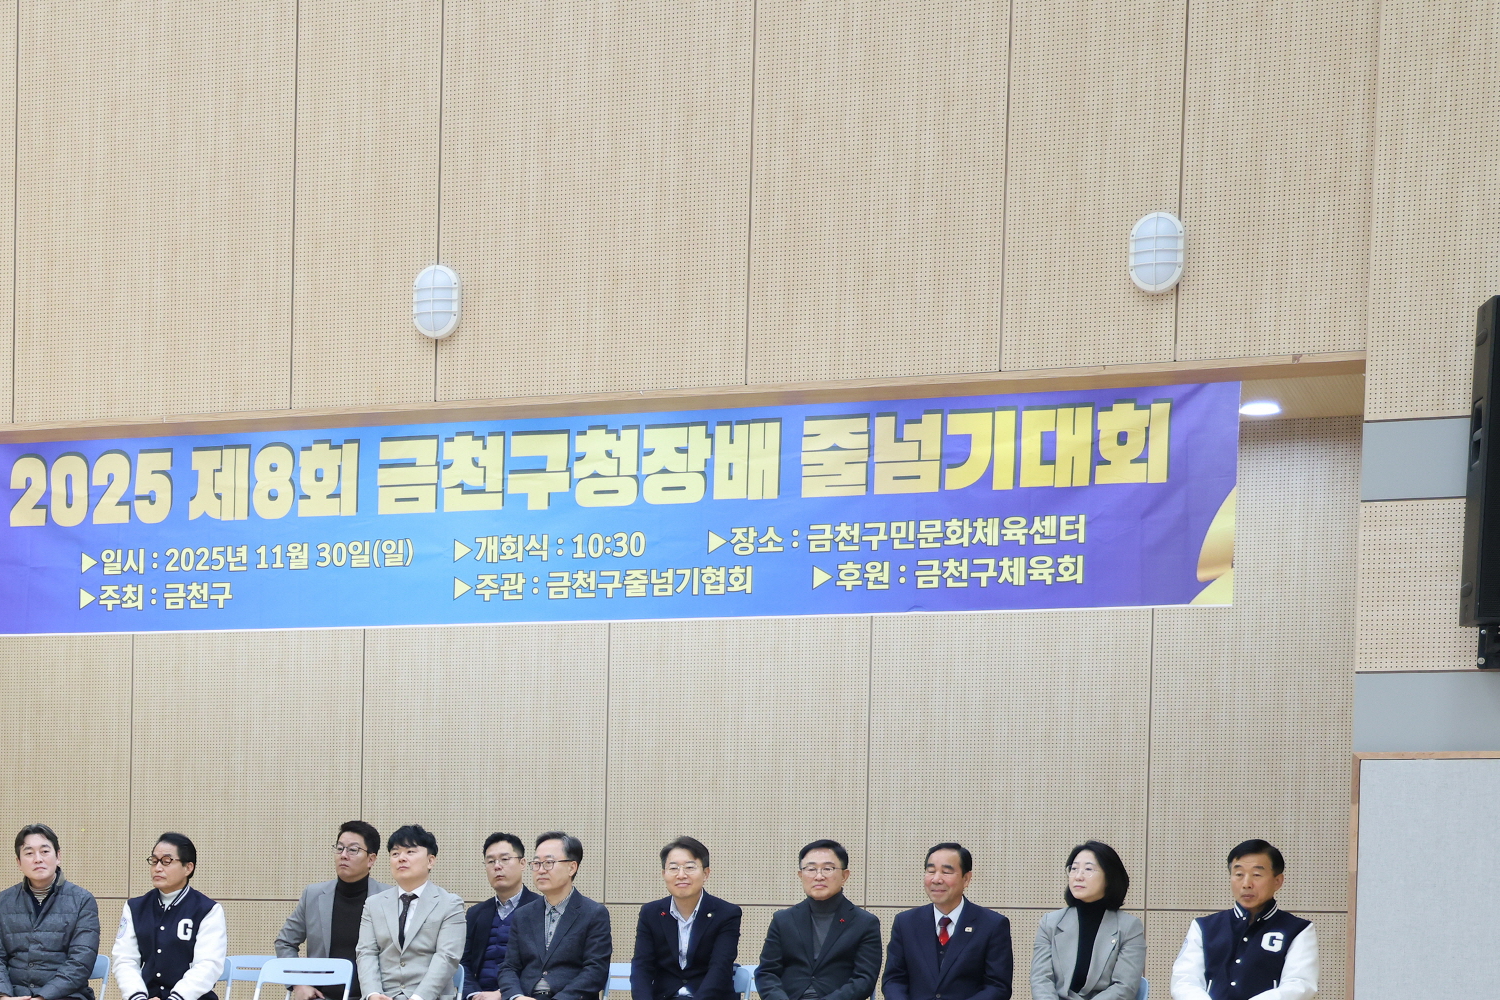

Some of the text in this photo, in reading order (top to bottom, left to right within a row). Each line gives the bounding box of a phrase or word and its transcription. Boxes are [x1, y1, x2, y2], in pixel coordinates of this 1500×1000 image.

[9, 398, 1173, 528] 2025 제8회 금천구청장배 줄넘기대회
[474, 533, 549, 563] 개회식
[571, 532, 646, 559] 10:30
[730, 526, 784, 555] 장소
[807, 515, 1086, 553] 금천구민문화체육센터
[100, 548, 144, 574] 일시
[165, 545, 248, 572] 2025년
[256, 543, 309, 569] 11월
[316, 538, 414, 568] 30일(일)
[835, 561, 890, 591] 후원
[914, 555, 1084, 589] 금천구체육회
[99, 583, 143, 610] 주최
[163, 582, 233, 609] 금천구
[474, 572, 525, 602] 주관
[546, 565, 753, 599] 금천구줄넘기협회
[177, 919, 193, 941] G
[1261, 932, 1284, 952] G
